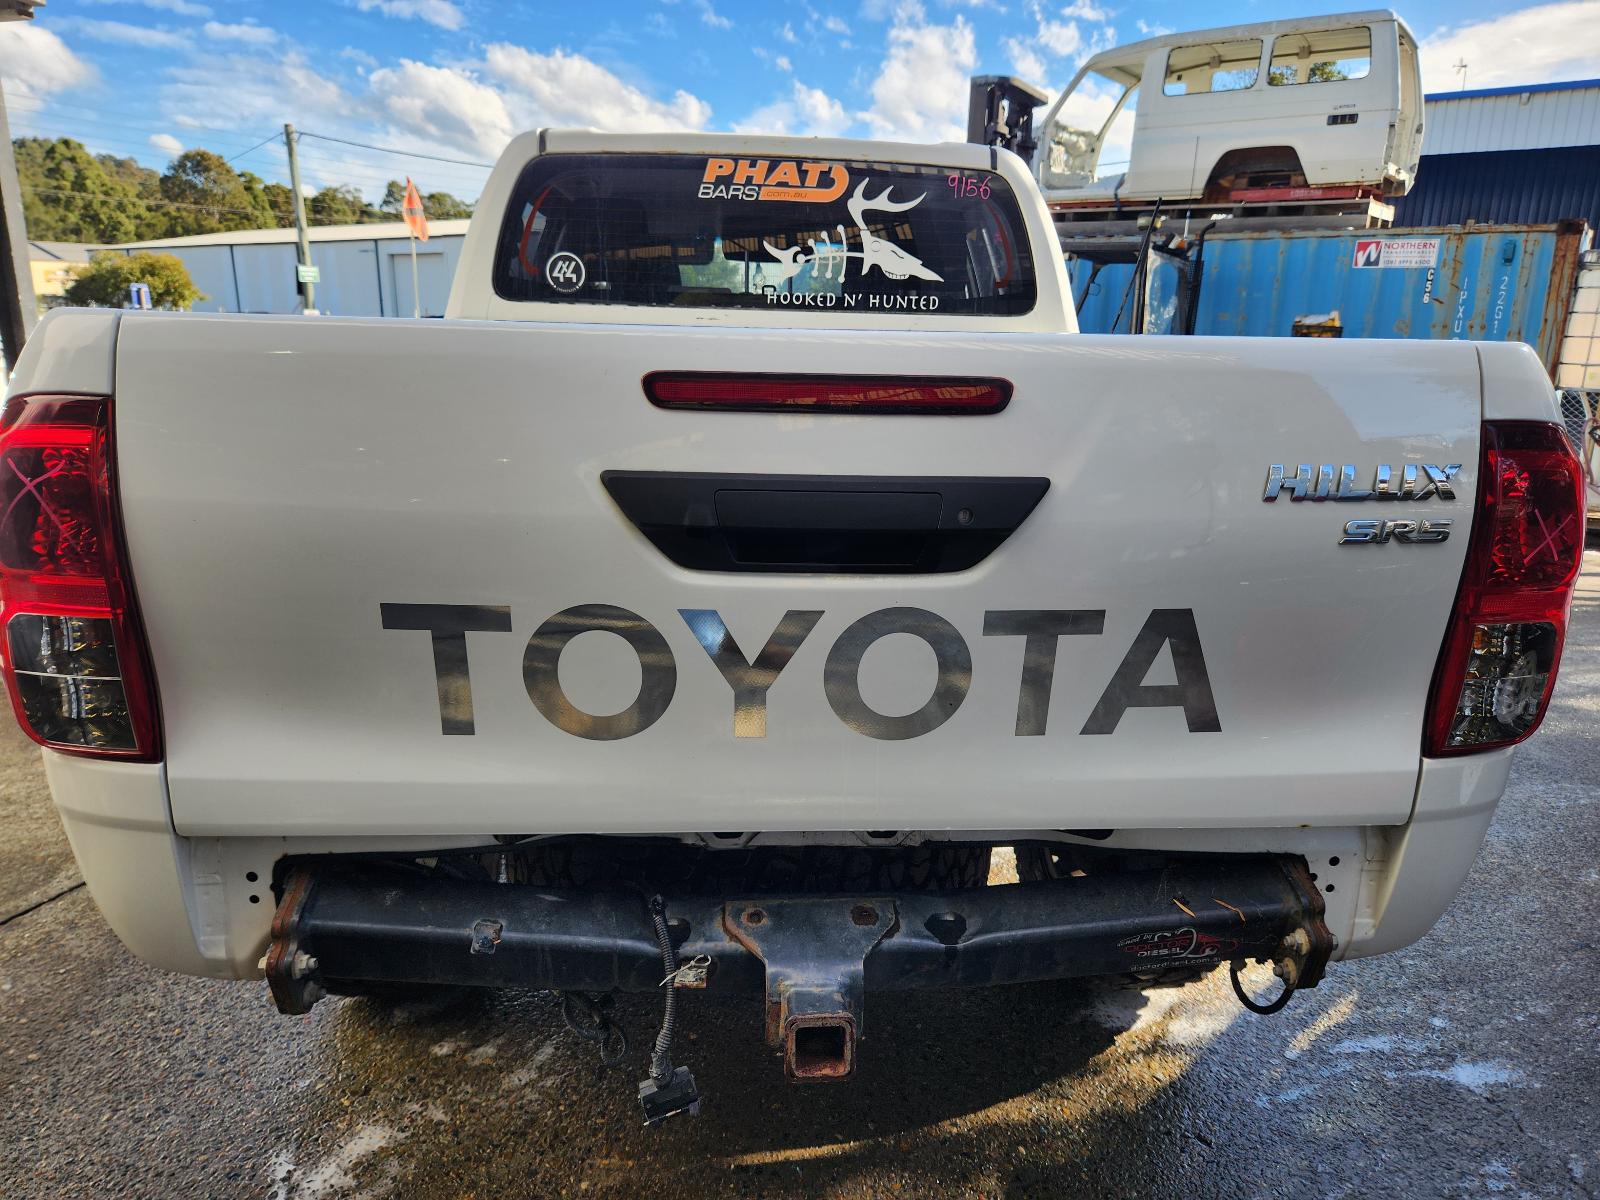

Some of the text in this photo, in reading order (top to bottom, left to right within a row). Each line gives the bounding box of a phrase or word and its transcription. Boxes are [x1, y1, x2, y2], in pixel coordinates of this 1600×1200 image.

[702, 158, 830, 188] PHAT
[698, 184, 760, 201] BARS
[948, 175, 992, 200] 9156
[1383, 242, 1437, 250] NORTHERN
[767, 291, 836, 307] HOOKED
[869, 294, 939, 310] HUNTED
[1263, 464, 1462, 502] HILUX
[1338, 519, 1453, 545] SR5
[380, 602, 1223, 741] TOYOTA
[1137, 947, 1185, 957] DIESEL
